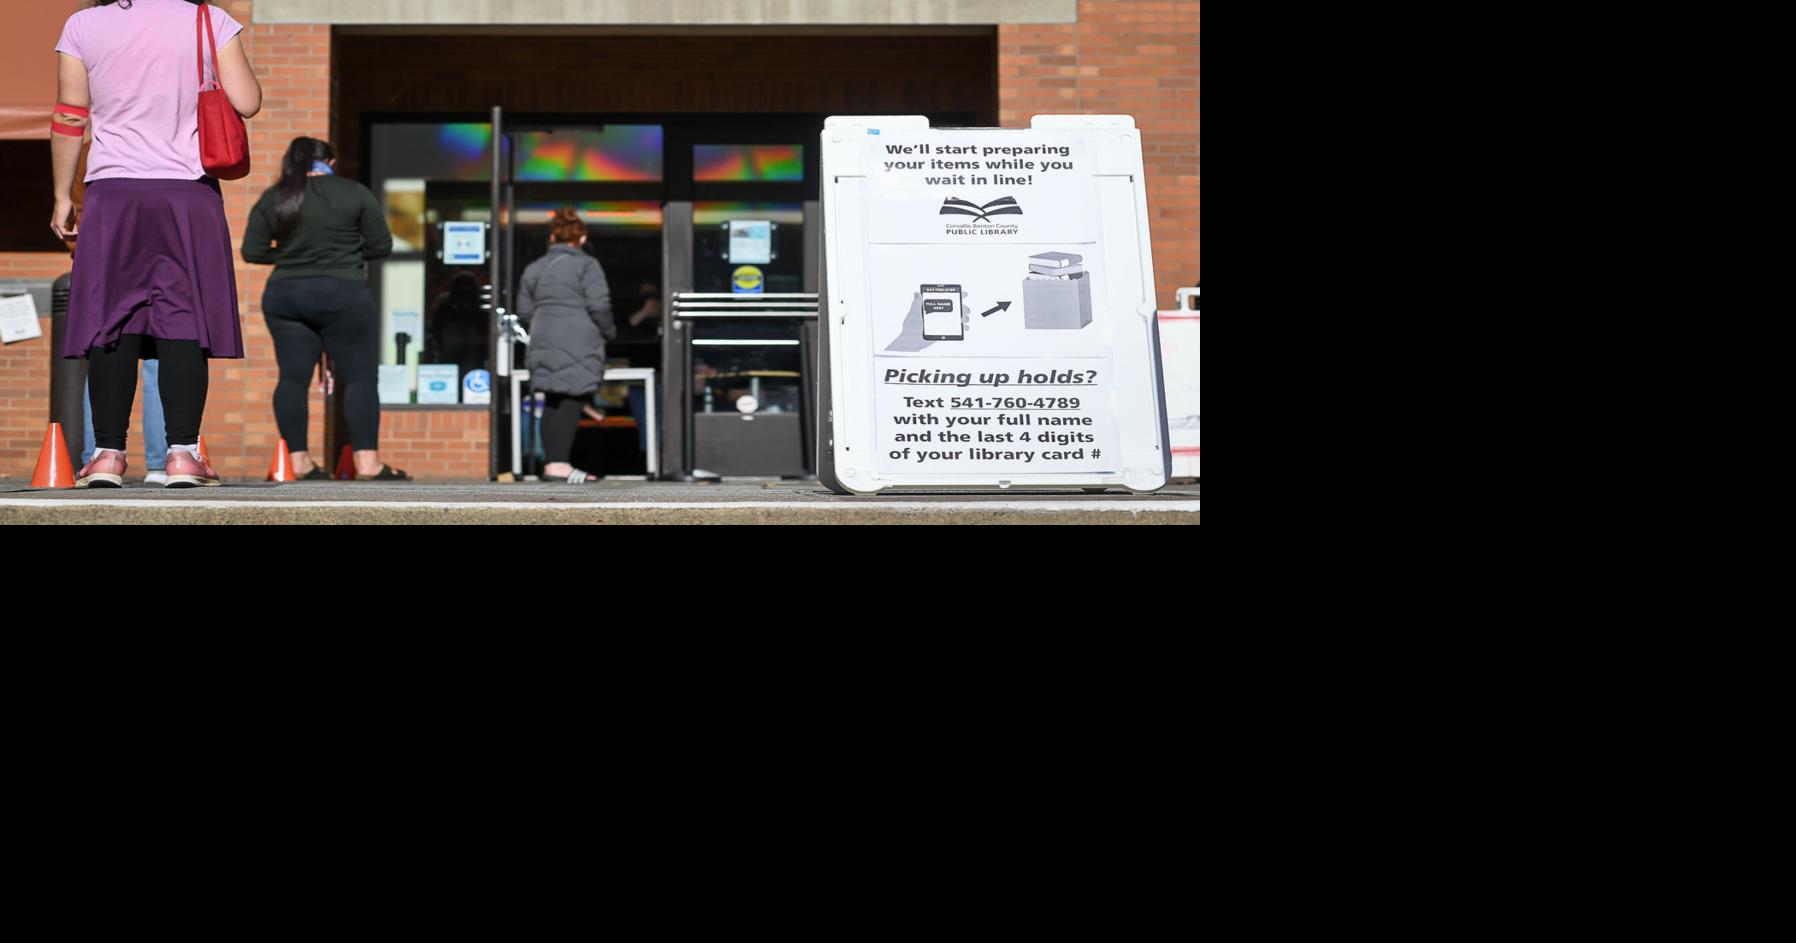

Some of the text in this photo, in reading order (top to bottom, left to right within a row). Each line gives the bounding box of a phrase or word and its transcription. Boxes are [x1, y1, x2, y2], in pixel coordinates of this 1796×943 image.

[886, 144, 1070, 157] We’ll start preparing
[884, 159, 1073, 173] your items while you
[925, 174, 1033, 186] wait in line!
[884, 369, 1098, 387] Picking up holds?
[903, 397, 1081, 410] Text 541-760-4789
[893, 413, 1093, 428] with your full name
[894, 431, 1095, 445] and the last 4 digits
[889, 448, 1102, 463] of your library card #
